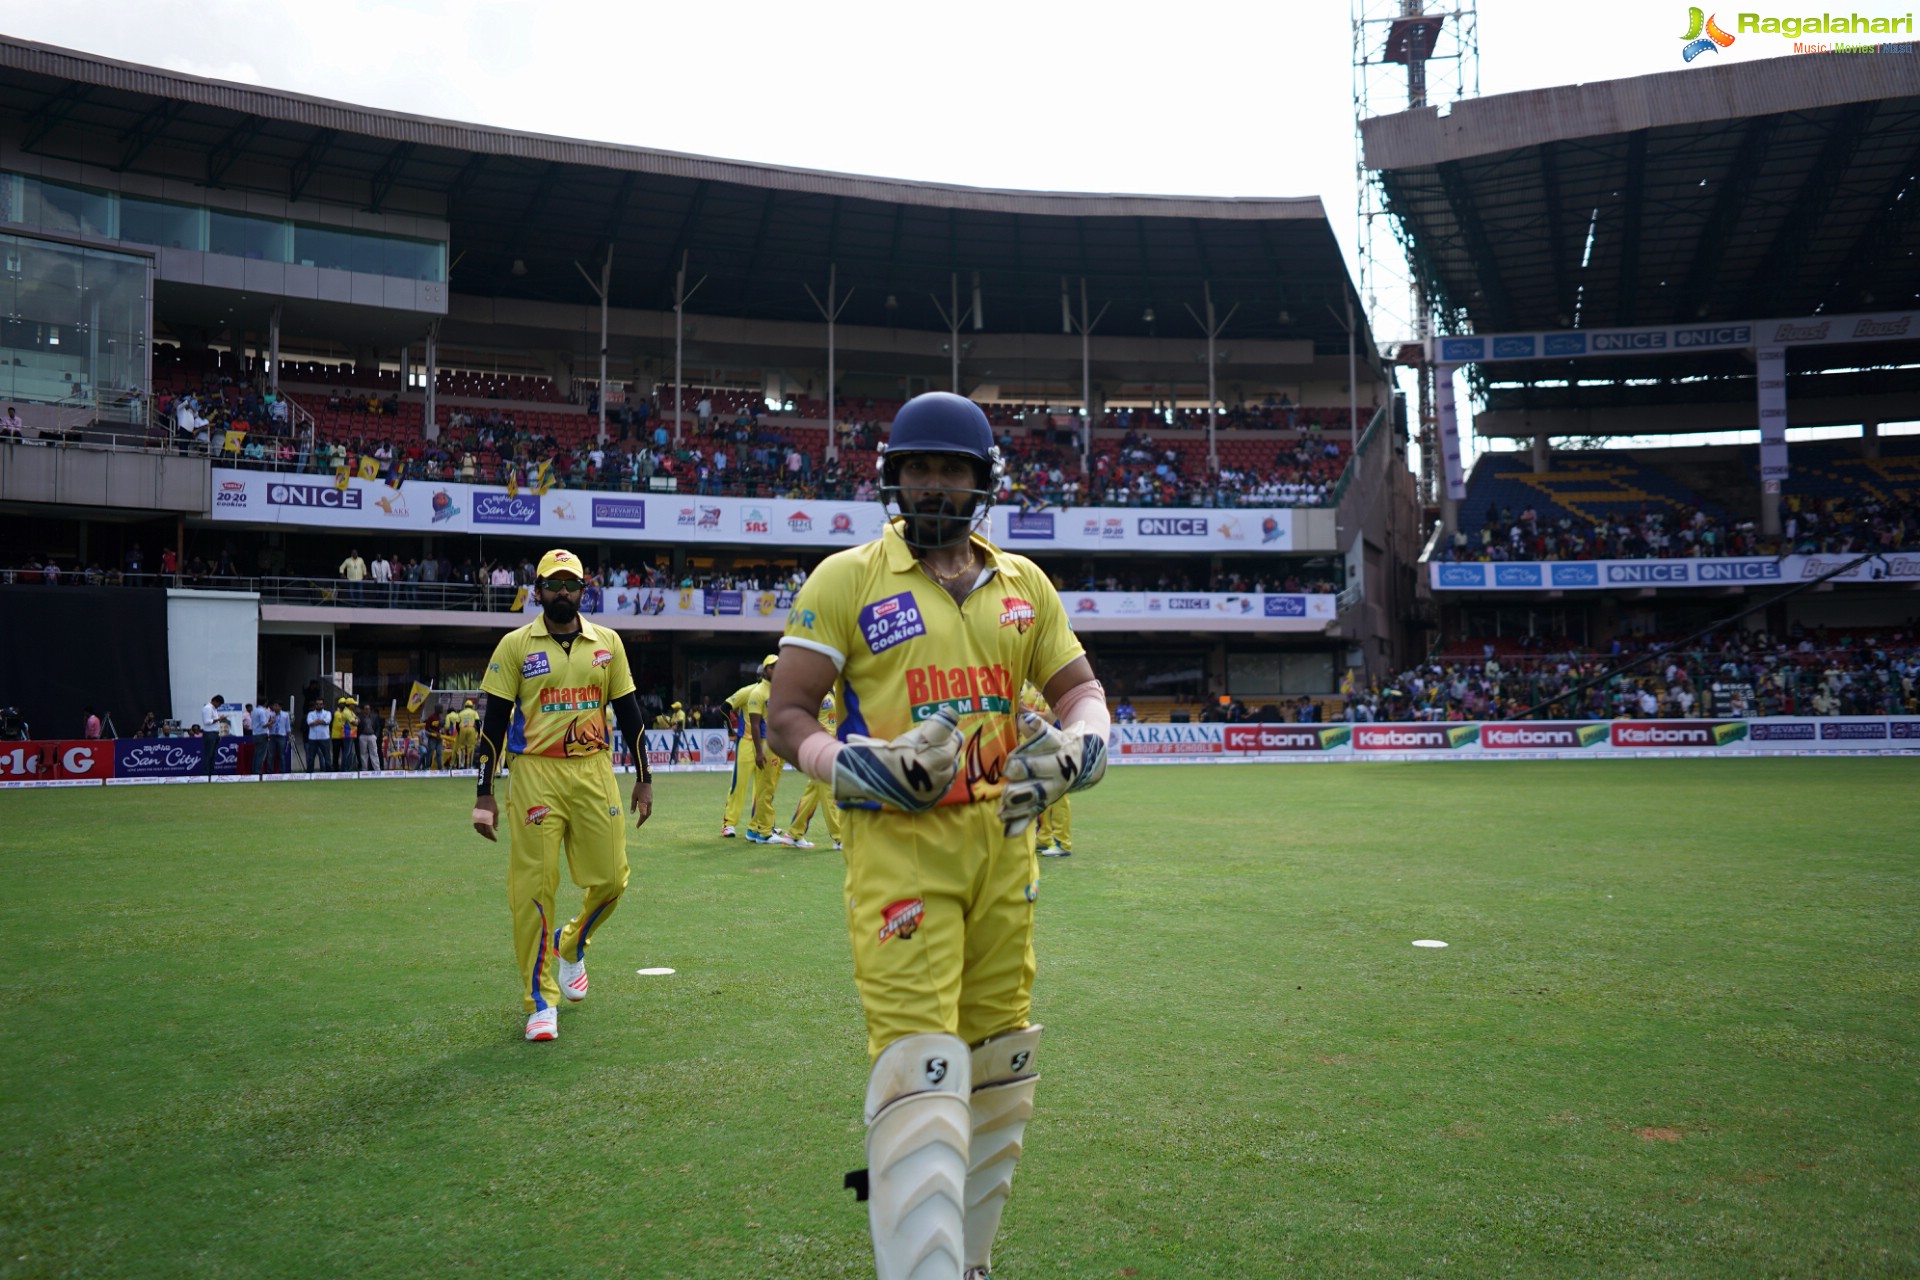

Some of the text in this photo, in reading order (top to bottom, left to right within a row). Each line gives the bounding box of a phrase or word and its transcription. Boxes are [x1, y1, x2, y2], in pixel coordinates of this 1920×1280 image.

[1775, 321, 1831, 342] Boost
[1853, 316, 1912, 338] Boost
[477, 498, 504, 515] San
[509, 499, 536, 522] City
[745, 521, 768, 533] SAS
[867, 608, 918, 640] 20-20
[871, 624, 922, 651] cookies
[522, 660, 547, 672] 20-20
[524, 667, 549, 677] cookies
[540, 683, 602, 709] Bharathi
[543, 702, 599, 711] CEMENT
[1122, 726, 1222, 742] NARAYANA
[1487, 728, 1573, 744] Karbonn
[1618, 727, 1708, 742] Karbonn
[1770, 725, 1813, 733] REVANTA
[1841, 724, 1885, 732] REVANTA
[1359, 729, 1443, 745] Karbonn
[1131, 743, 1213, 753] GROUP OF SCHOOLS
[63, 747, 95, 774] G
[122, 748, 202, 771] San City
